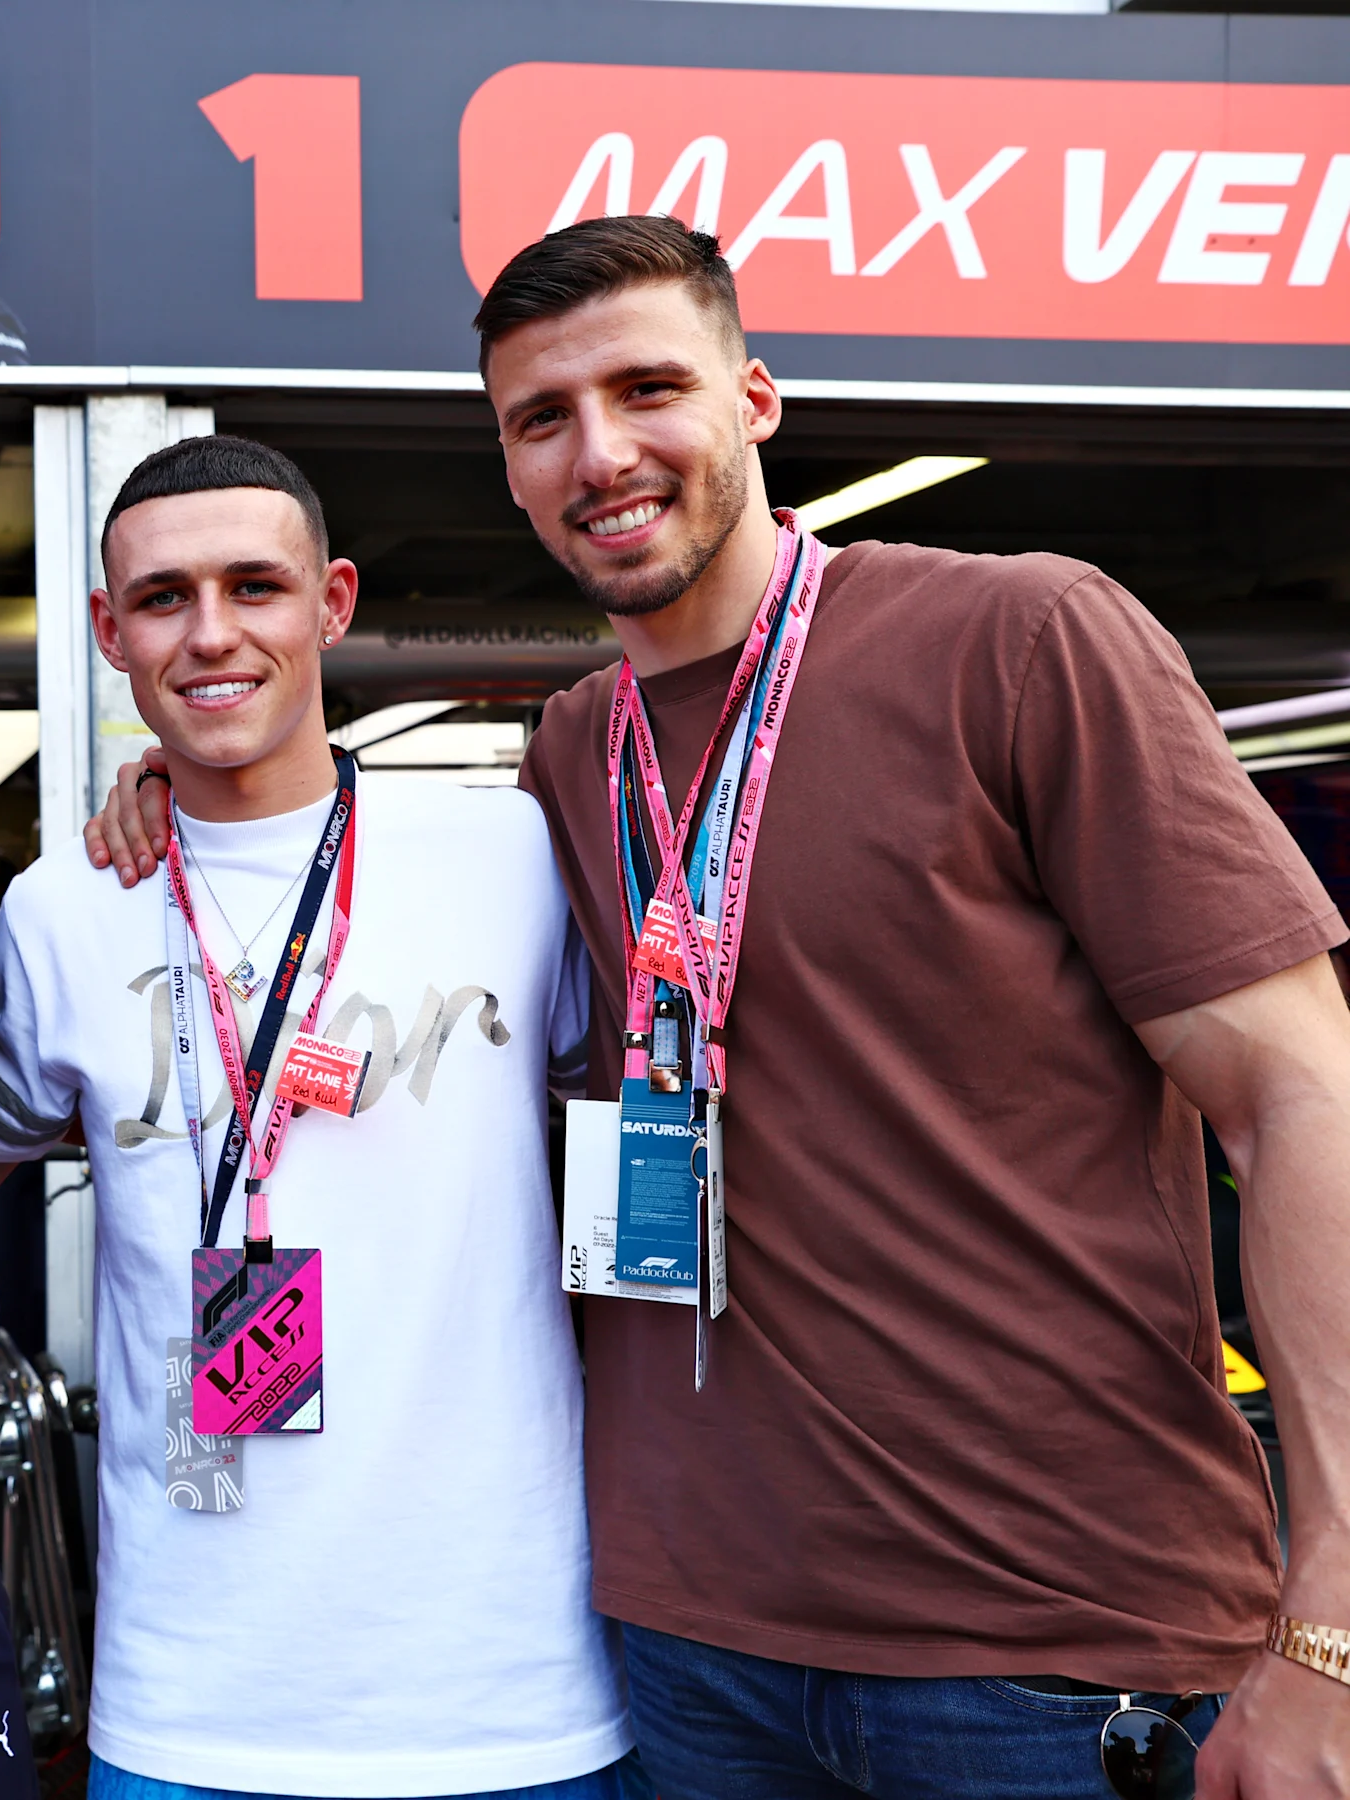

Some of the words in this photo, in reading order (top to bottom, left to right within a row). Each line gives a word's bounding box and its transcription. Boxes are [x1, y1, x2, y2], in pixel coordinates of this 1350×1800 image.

[196, 72, 364, 302] 1
[543, 131, 1028, 279] MAX
[742, 777, 761, 816] 2022
[317, 803, 349, 871] MONACO
[339, 787, 353, 807] 22
[713, 779, 733, 856] ALPHATAURI
[658, 866, 672, 894] 2030
[642, 932, 665, 949] PIT
[648, 956, 666, 973] Red
[173, 966, 189, 1035] ALPHATAURI
[636, 981, 648, 1003] NET
[219, 1028, 232, 1053] 2030
[224, 1054, 235, 1068] BY
[285, 1062, 307, 1078] PIT
[307, 1070, 343, 1089] LANE
[228, 1070, 244, 1109] CARBON
[292, 1085, 310, 1099] Red
[570, 1245, 581, 1290] VIP
[622, 1265, 669, 1279] Paddock
[669, 1270, 694, 1281] Club
[205, 1288, 304, 1397] VIP
[209, 1332, 225, 1348] FIA
[228, 1321, 305, 1405] ACCESS
[250, 1362, 302, 1423] 2022
[222, 1454, 237, 1465] 22
